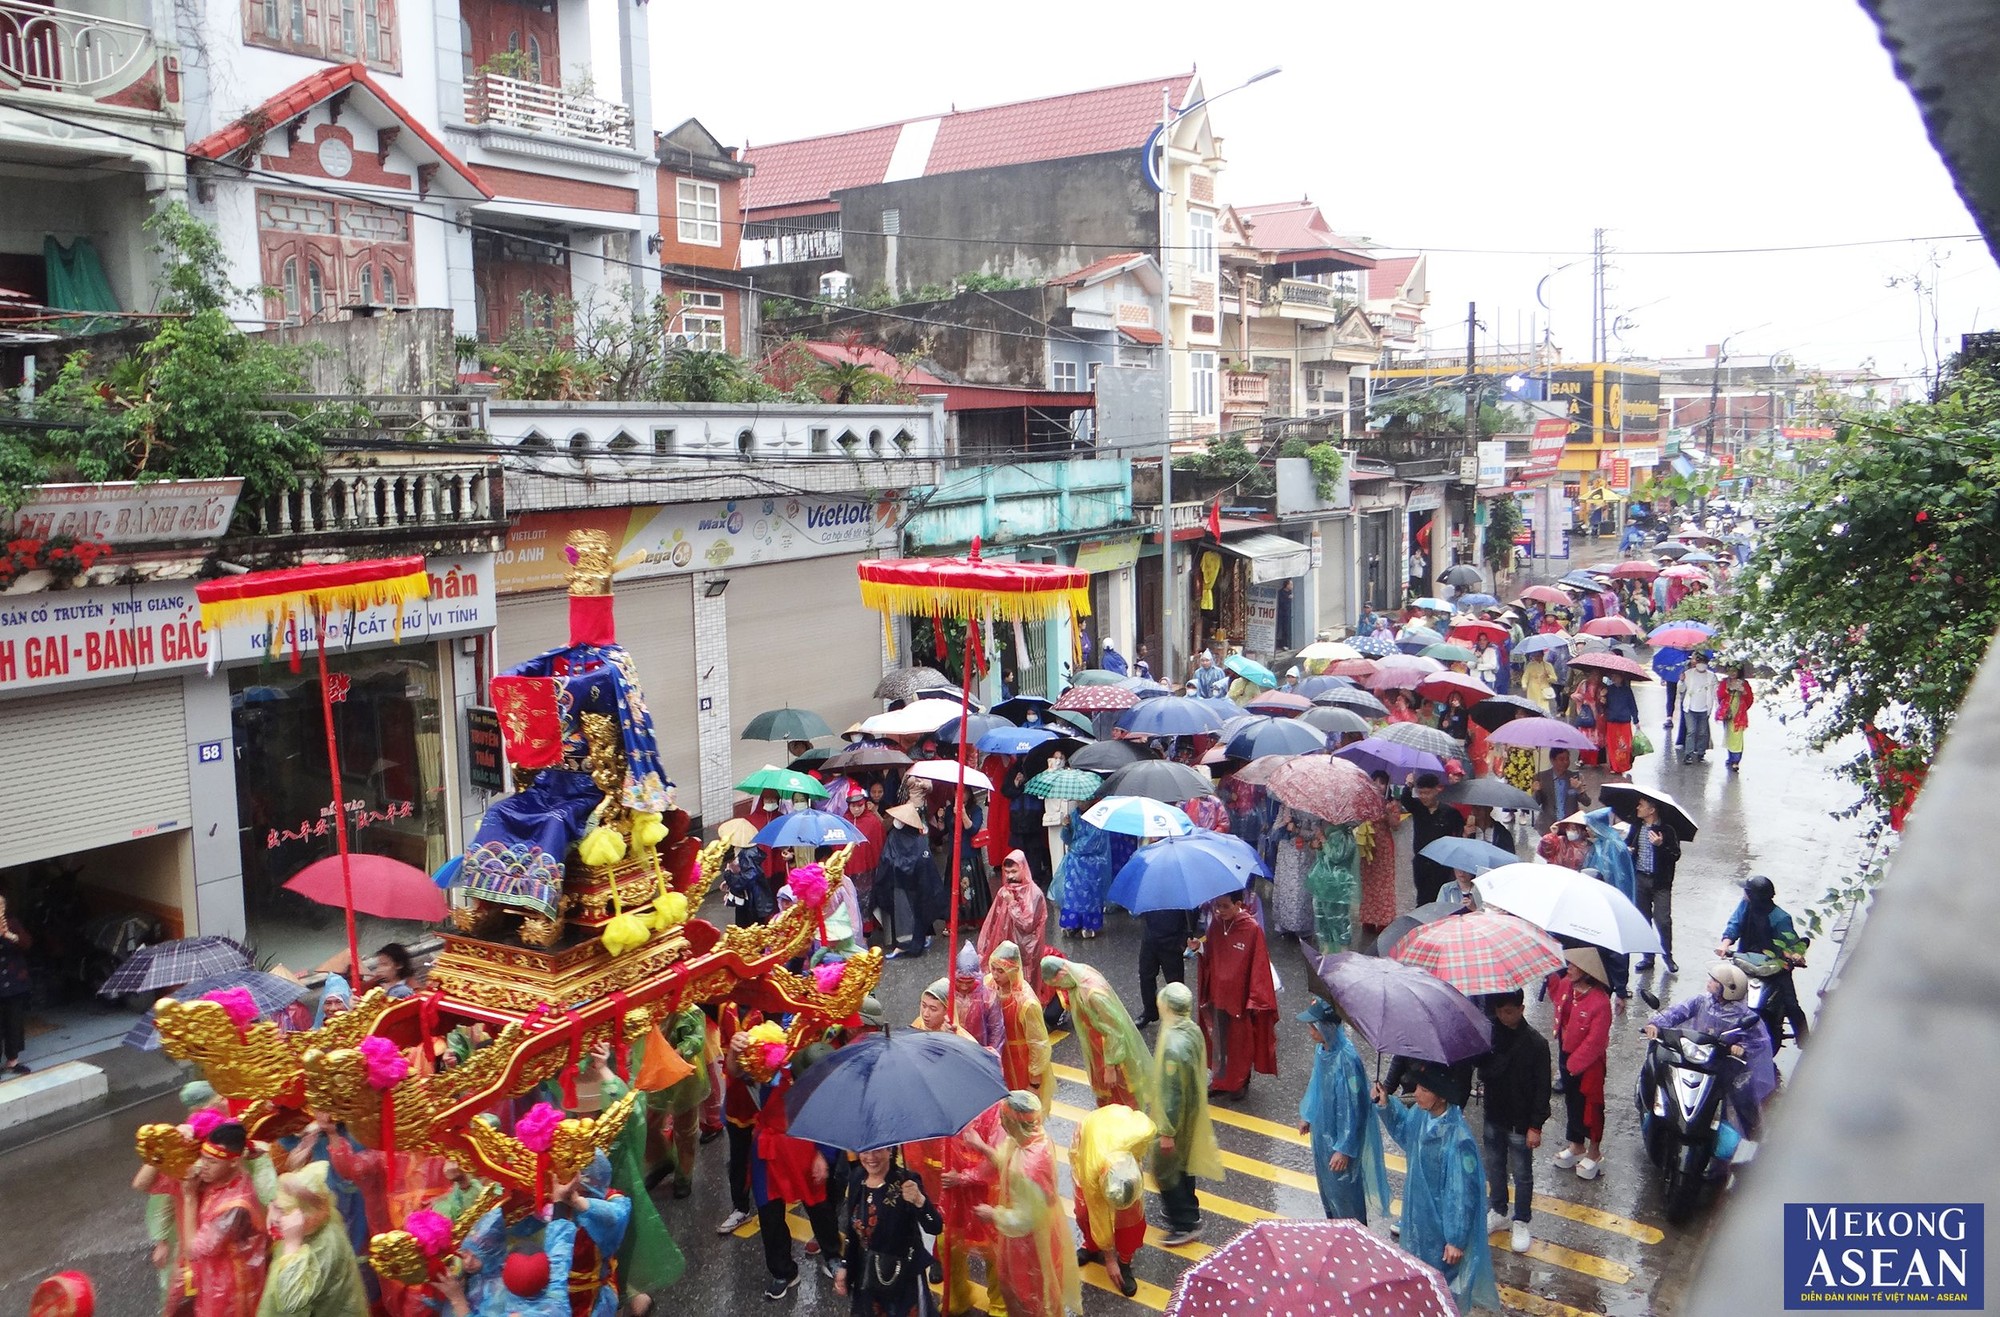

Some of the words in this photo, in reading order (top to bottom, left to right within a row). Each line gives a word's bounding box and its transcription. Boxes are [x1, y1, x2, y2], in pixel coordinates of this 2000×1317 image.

[150, 486, 183, 497] NINH
[185, 484, 225, 496] GIANG
[179, 497, 225, 532] GẤC
[807, 502, 874, 529] Vietlott
[511, 529, 548, 542] VIETLOTT
[517, 547, 545, 563] ANH
[427, 564, 479, 600] hần
[1, 605, 28, 626] SẢN
[31, 601, 48, 623] CỔ
[54, 599, 104, 622] TRUYỀN
[112, 600, 143, 616] NINH
[147, 596, 184, 612] GIANG
[429, 613, 442, 626] VI
[450, 604, 478, 624] TÍNH
[161, 605, 208, 663] GẤC
[202, 745, 220, 761] 58
